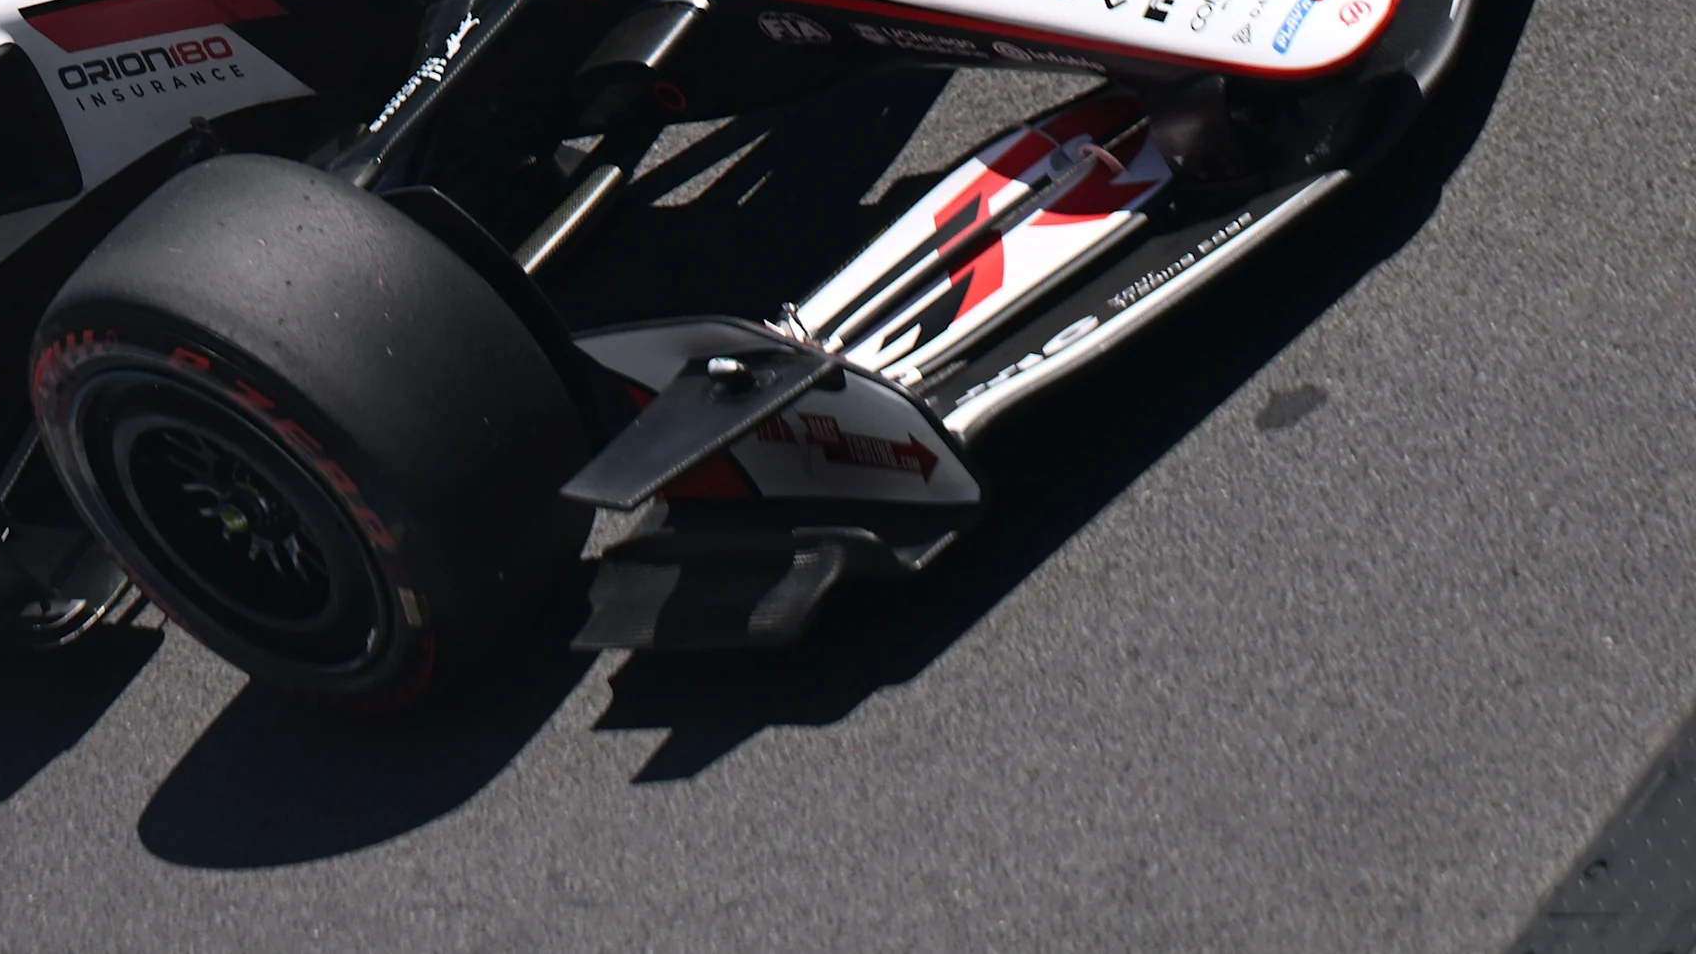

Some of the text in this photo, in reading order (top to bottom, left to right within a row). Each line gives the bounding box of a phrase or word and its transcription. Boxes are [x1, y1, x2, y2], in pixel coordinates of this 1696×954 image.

[771, 14, 820, 42] FIA
[57, 34, 235, 92] ORION180
[75, 63, 246, 112] INSURANCE
